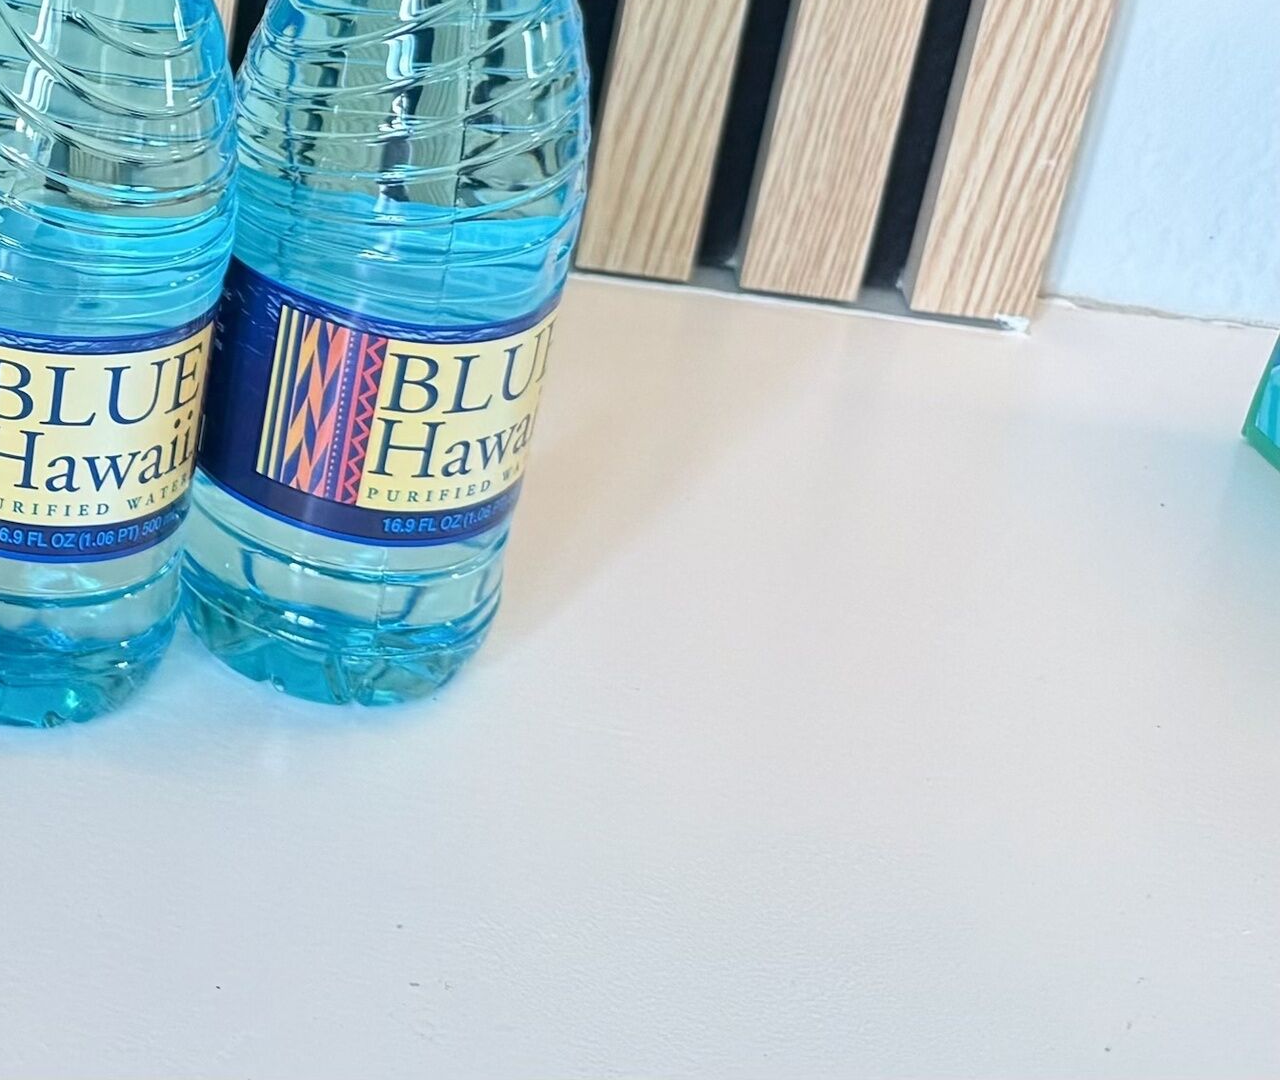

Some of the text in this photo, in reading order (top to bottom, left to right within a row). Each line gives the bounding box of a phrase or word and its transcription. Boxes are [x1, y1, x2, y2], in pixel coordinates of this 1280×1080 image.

[126, 471, 190, 511] WATER
[367, 479, 492, 503] PURIFIED
[27, 533, 48, 548] FL
[51, 532, 76, 549] OZ
[77, 529, 114, 551] (1.06
[116, 524, 140, 545] PT)
[141, 516, 163, 537] 500
[382, 517, 416, 534] 16.9
[418, 518, 437, 533] FL
[440, 513, 461, 531] OZ
